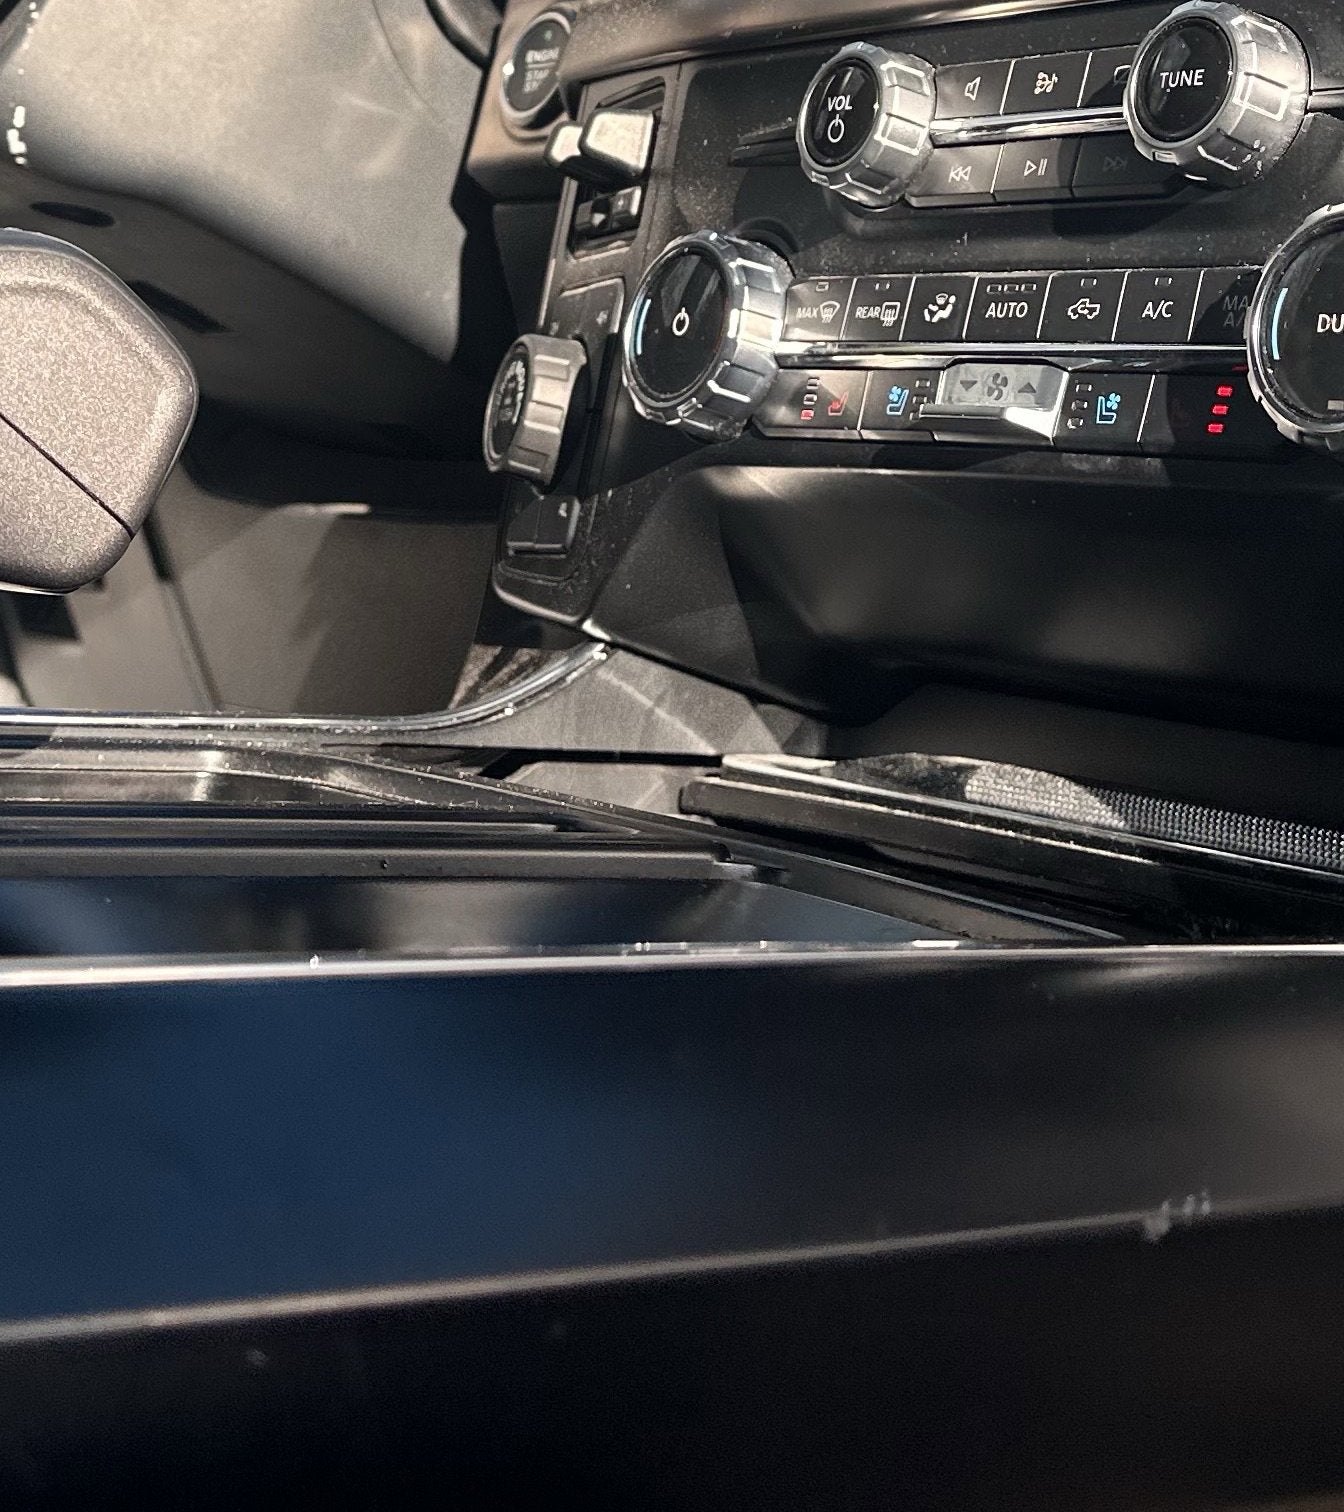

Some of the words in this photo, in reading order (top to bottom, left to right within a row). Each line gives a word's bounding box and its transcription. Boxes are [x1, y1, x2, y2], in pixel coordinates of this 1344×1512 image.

[1159, 69, 1205, 88] TUNE
[828, 94, 853, 111] VOL
[985, 301, 1028, 318] AUTO
[1142, 300, 1174, 319] A/C
[1222, 295, 1249, 310] MA
[796, 307, 818, 319] MAX
[855, 306, 880, 319] REAR
[1223, 312, 1245, 328] A/
